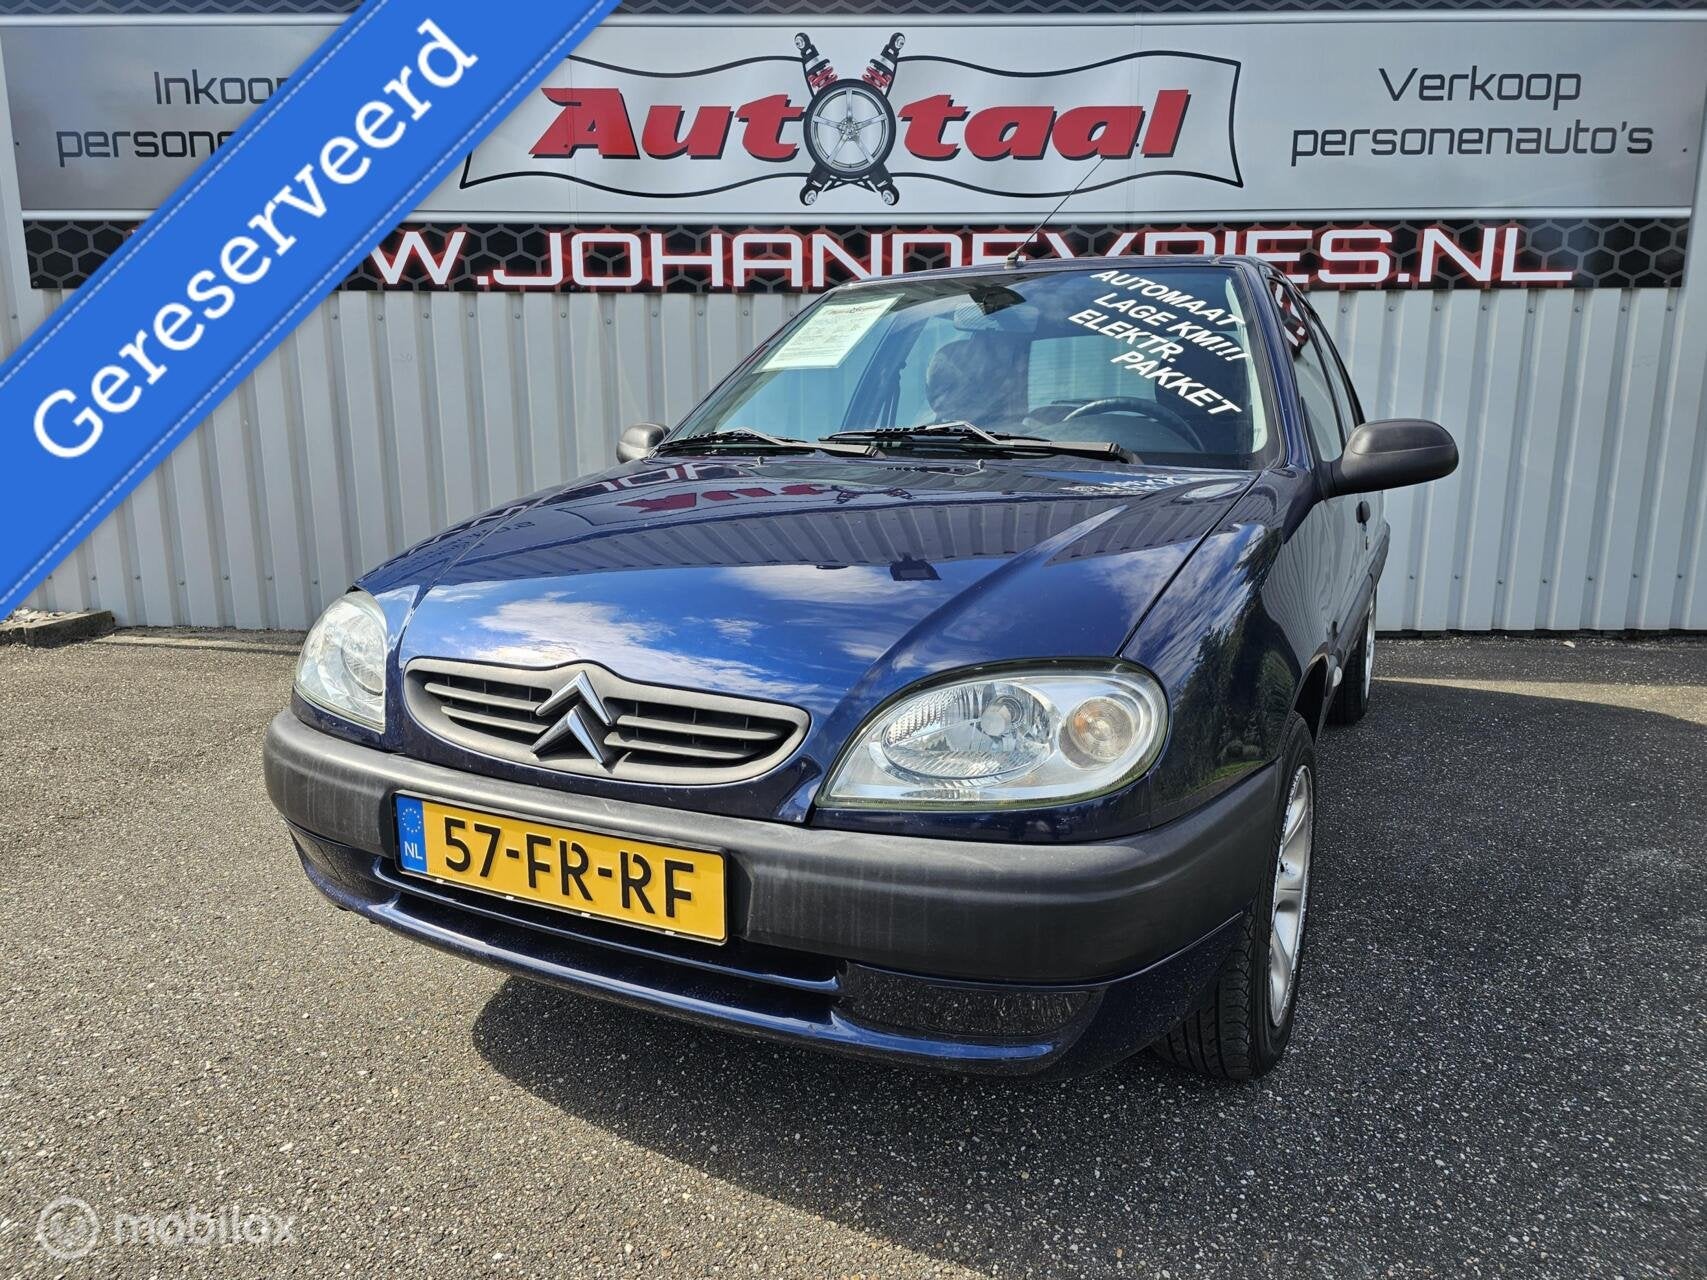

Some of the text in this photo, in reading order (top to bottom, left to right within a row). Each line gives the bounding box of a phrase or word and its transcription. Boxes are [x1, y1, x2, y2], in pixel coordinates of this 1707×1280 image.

[154, 69, 288, 104] Inkoo
[1378, 65, 1582, 110] Verkoop
[1291, 119, 1653, 166] personenauto's
[1089, 270, 1246, 326] AUTOMAAT
[1067, 308, 1184, 363] ELEKTR.
[1094, 292, 1250, 362] LAGE KM!!!
[1110, 351, 1243, 415] PAKKET
[404, 841, 424, 861] NL
[444, 816, 695, 919] 57-FR-RF
